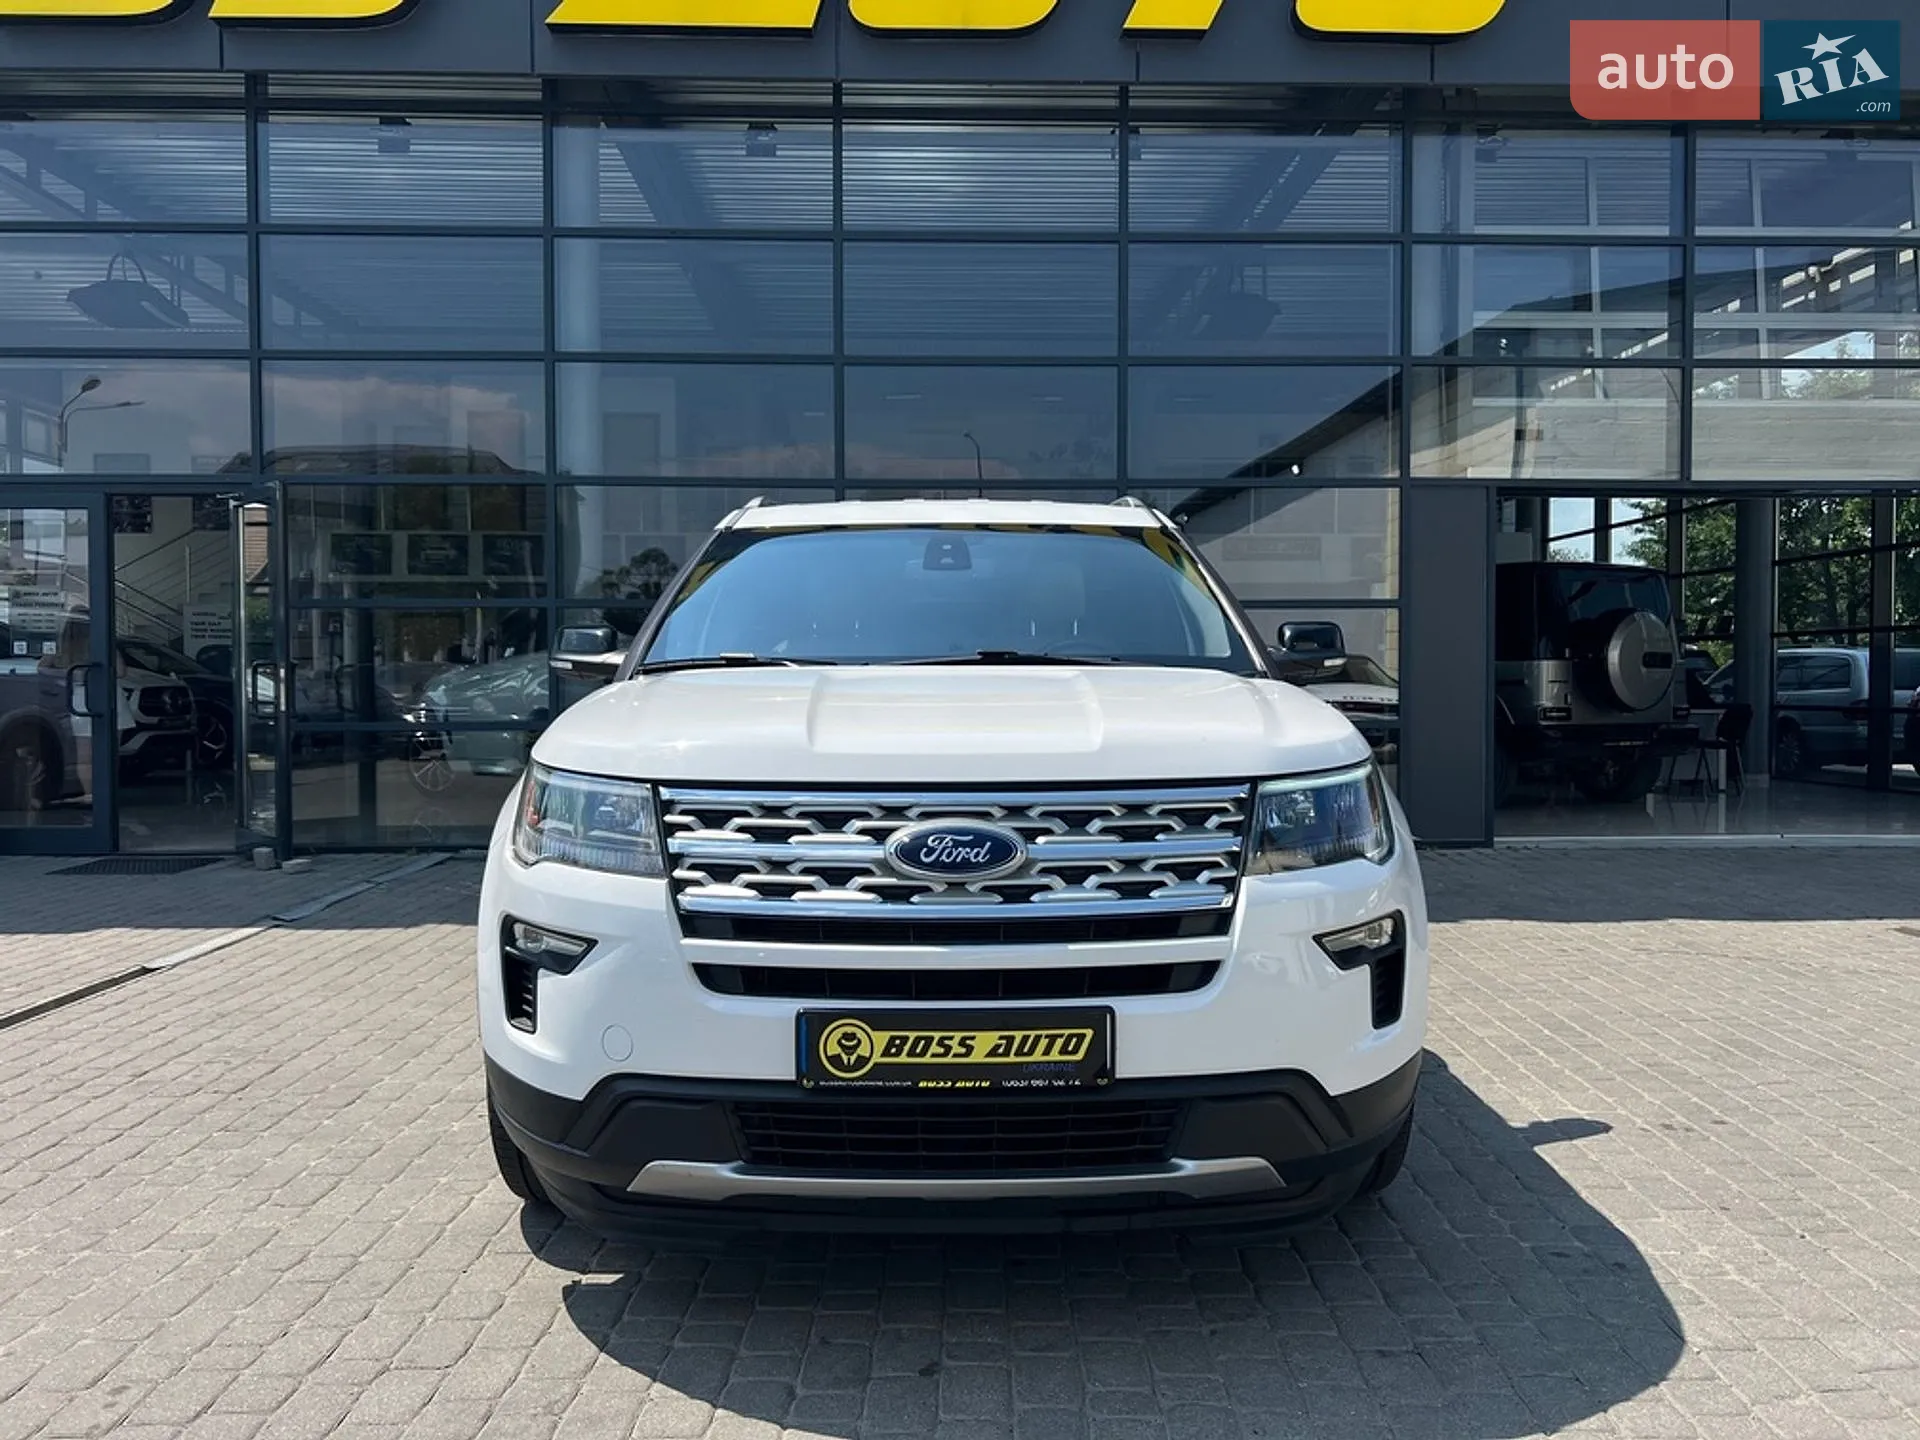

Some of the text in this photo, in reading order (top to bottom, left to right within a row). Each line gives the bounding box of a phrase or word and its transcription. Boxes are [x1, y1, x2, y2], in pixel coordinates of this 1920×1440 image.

[920, 834, 992, 864] Ford
[879, 1032, 1087, 1058] BOSS AUTO
